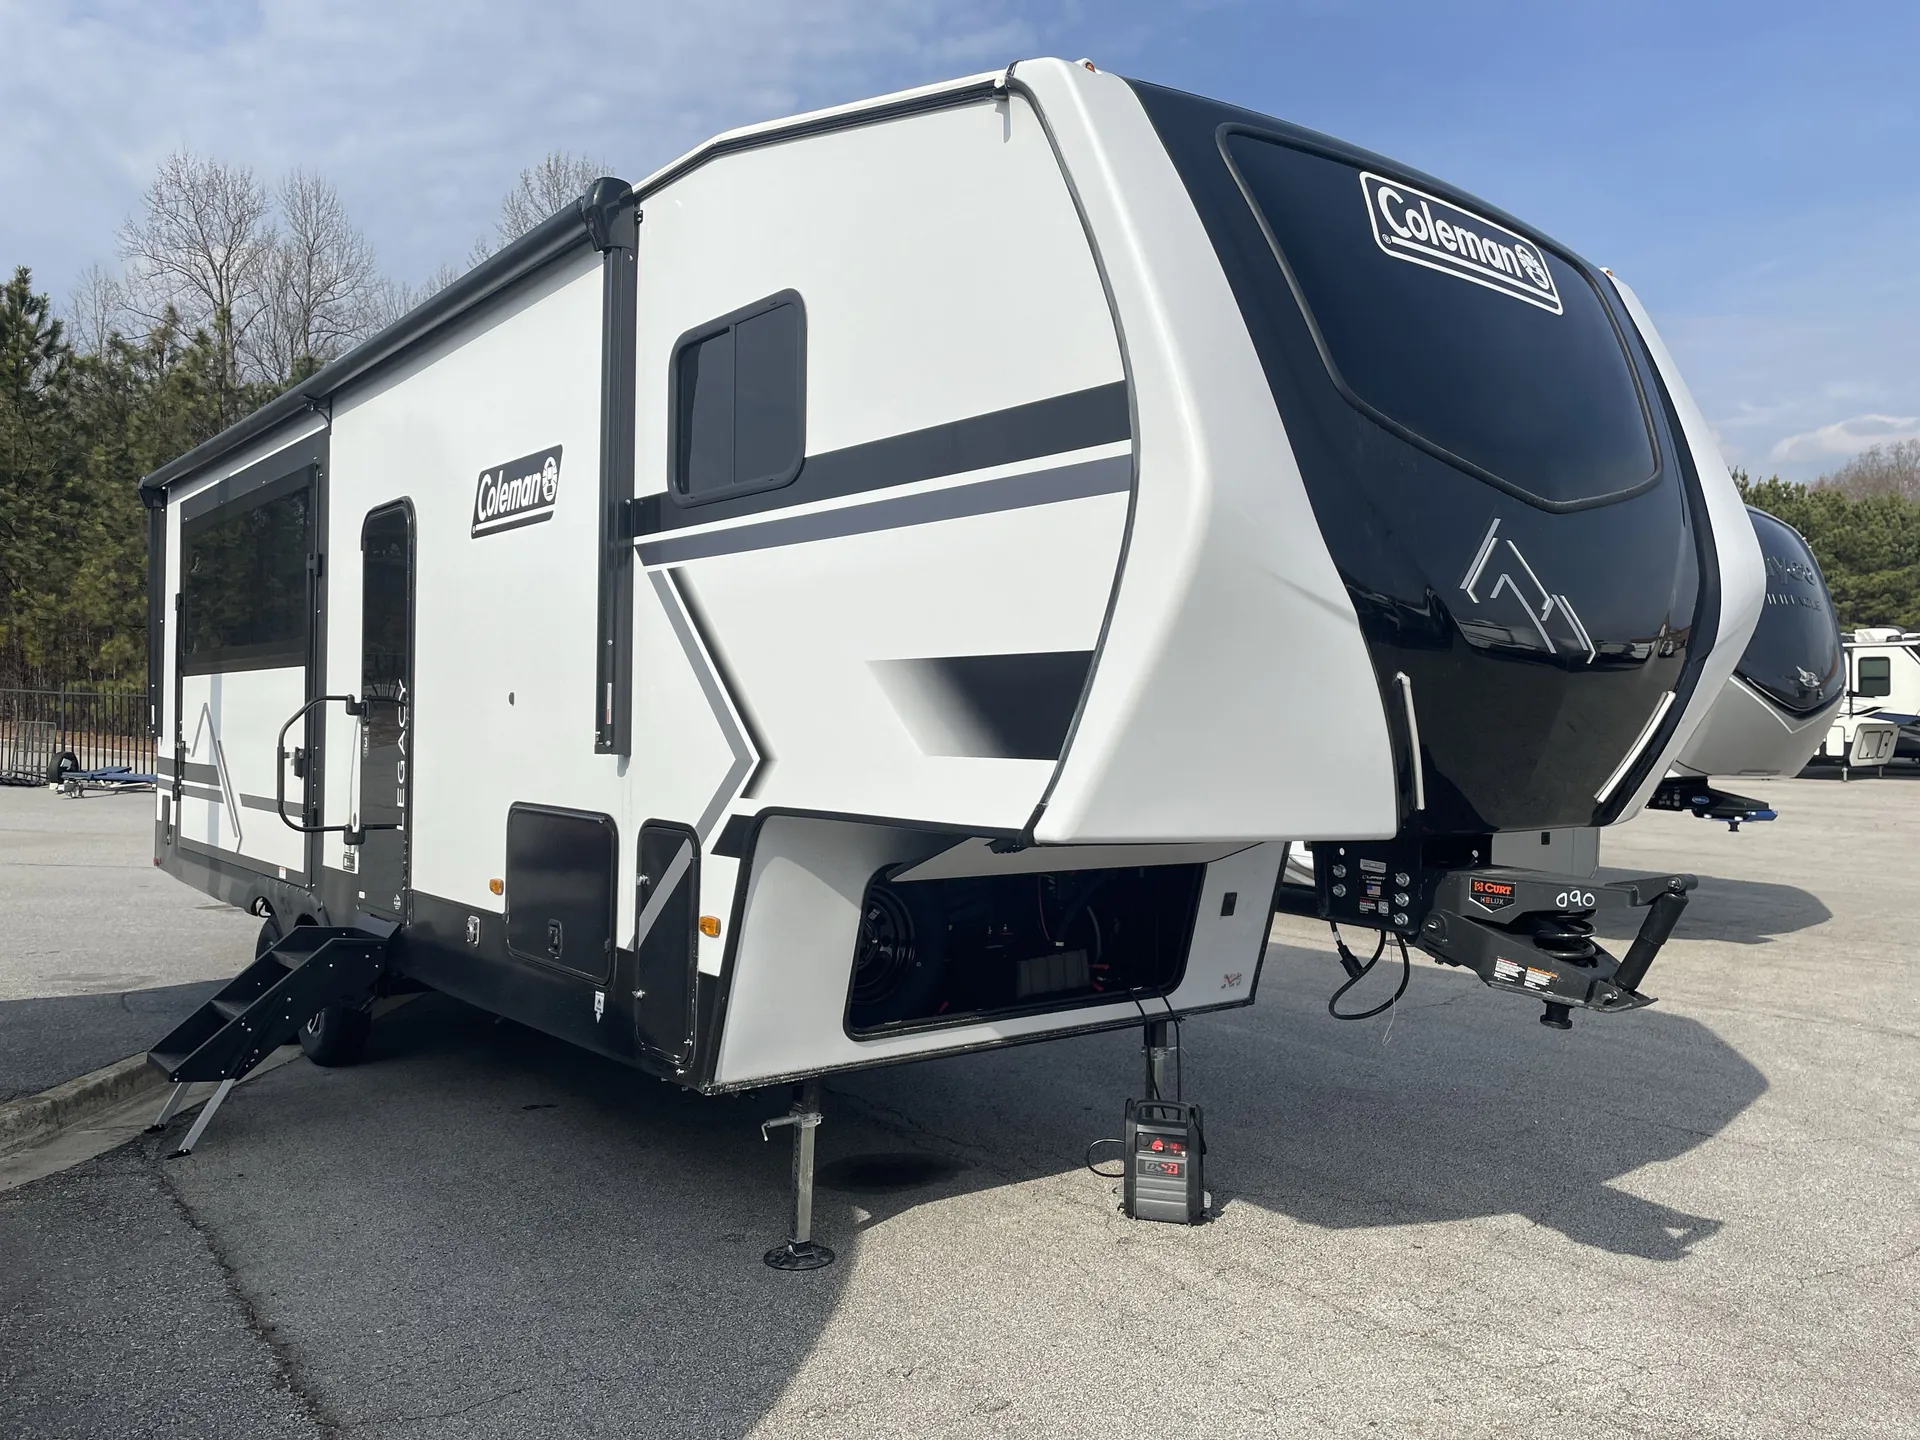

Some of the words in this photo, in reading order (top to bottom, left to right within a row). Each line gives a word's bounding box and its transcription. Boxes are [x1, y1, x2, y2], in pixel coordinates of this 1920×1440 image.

[1377, 186, 1523, 279] Coleman
[478, 469, 541, 521] Coleman
[396, 679, 407, 831] LEGACY
[1480, 896, 1504, 905] HELUX
[1484, 883, 1512, 895] CURT
[1556, 889, 1595, 908] 090
